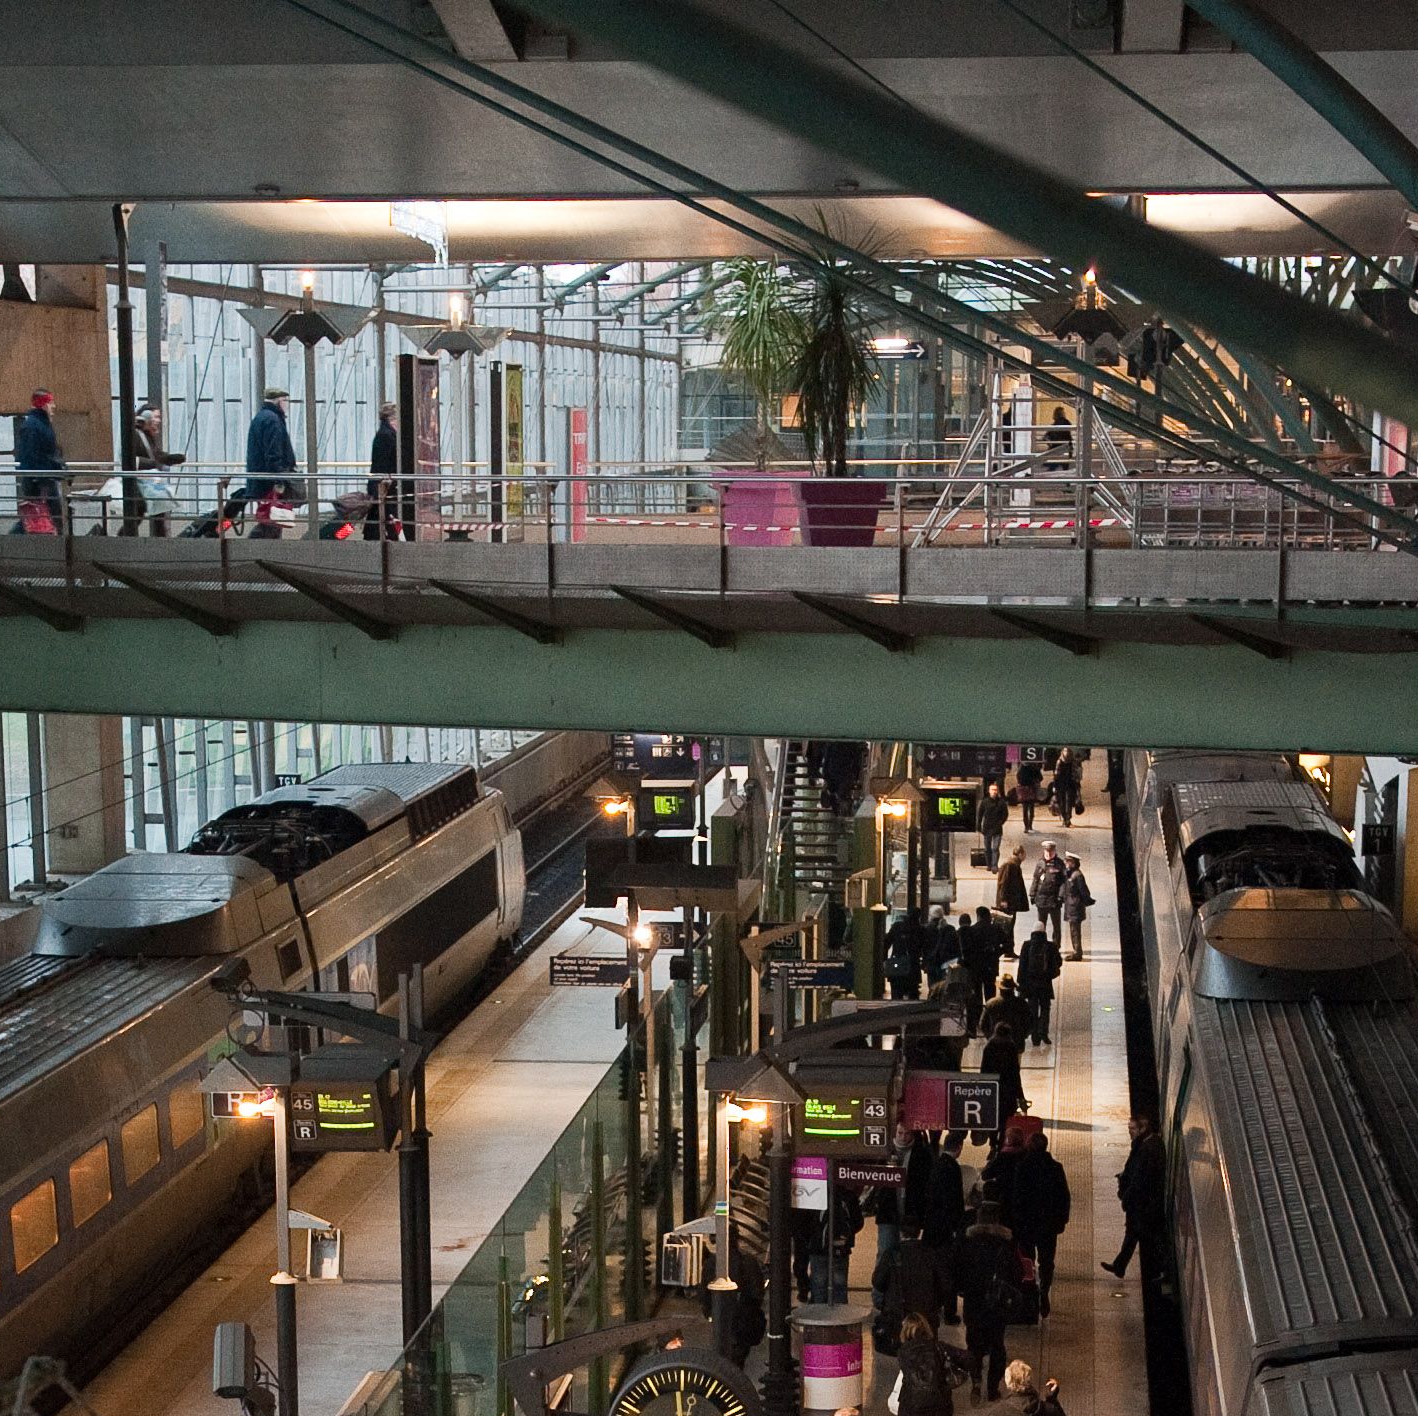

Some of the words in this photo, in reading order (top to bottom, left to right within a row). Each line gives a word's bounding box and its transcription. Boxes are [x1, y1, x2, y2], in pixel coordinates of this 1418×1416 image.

[1026, 747, 1037, 760] S
[278, 776, 297, 786] TGV
[1368, 826, 1389, 837] TGV
[954, 1085, 992, 1098] Repère
[292, 1098, 313, 1111] 45
[865, 1104, 885, 1117] 43
[964, 1100, 982, 1124] R
[300, 1126, 311, 1138] R
[870, 1133, 881, 1145] R
[838, 1166, 902, 1182] Bienvenue
